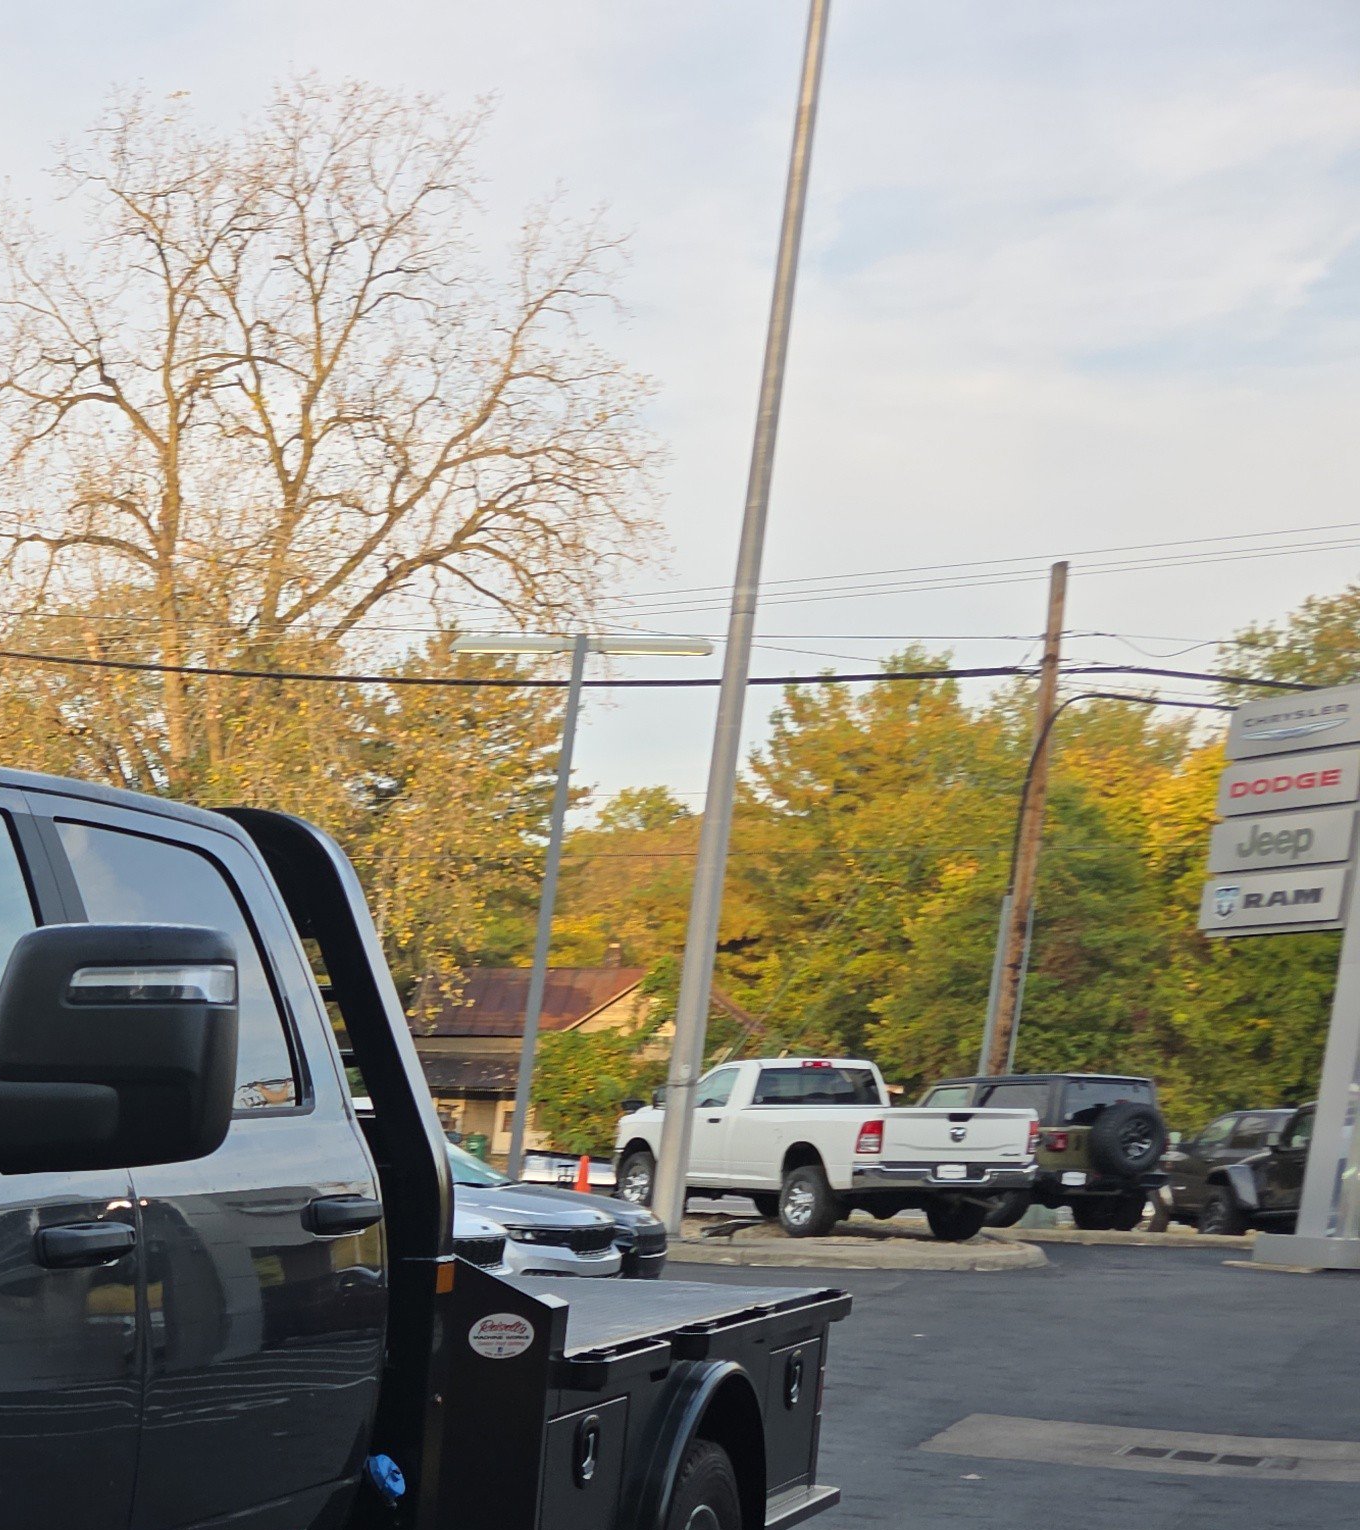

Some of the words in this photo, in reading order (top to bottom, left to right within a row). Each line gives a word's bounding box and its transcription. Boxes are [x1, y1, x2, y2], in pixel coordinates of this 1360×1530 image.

[1243, 703, 1349, 728] CHRYSLER
[1229, 768, 1342, 799] DODGE
[1236, 824, 1314, 859] Jeep
[1242, 887, 1323, 910] RAM
